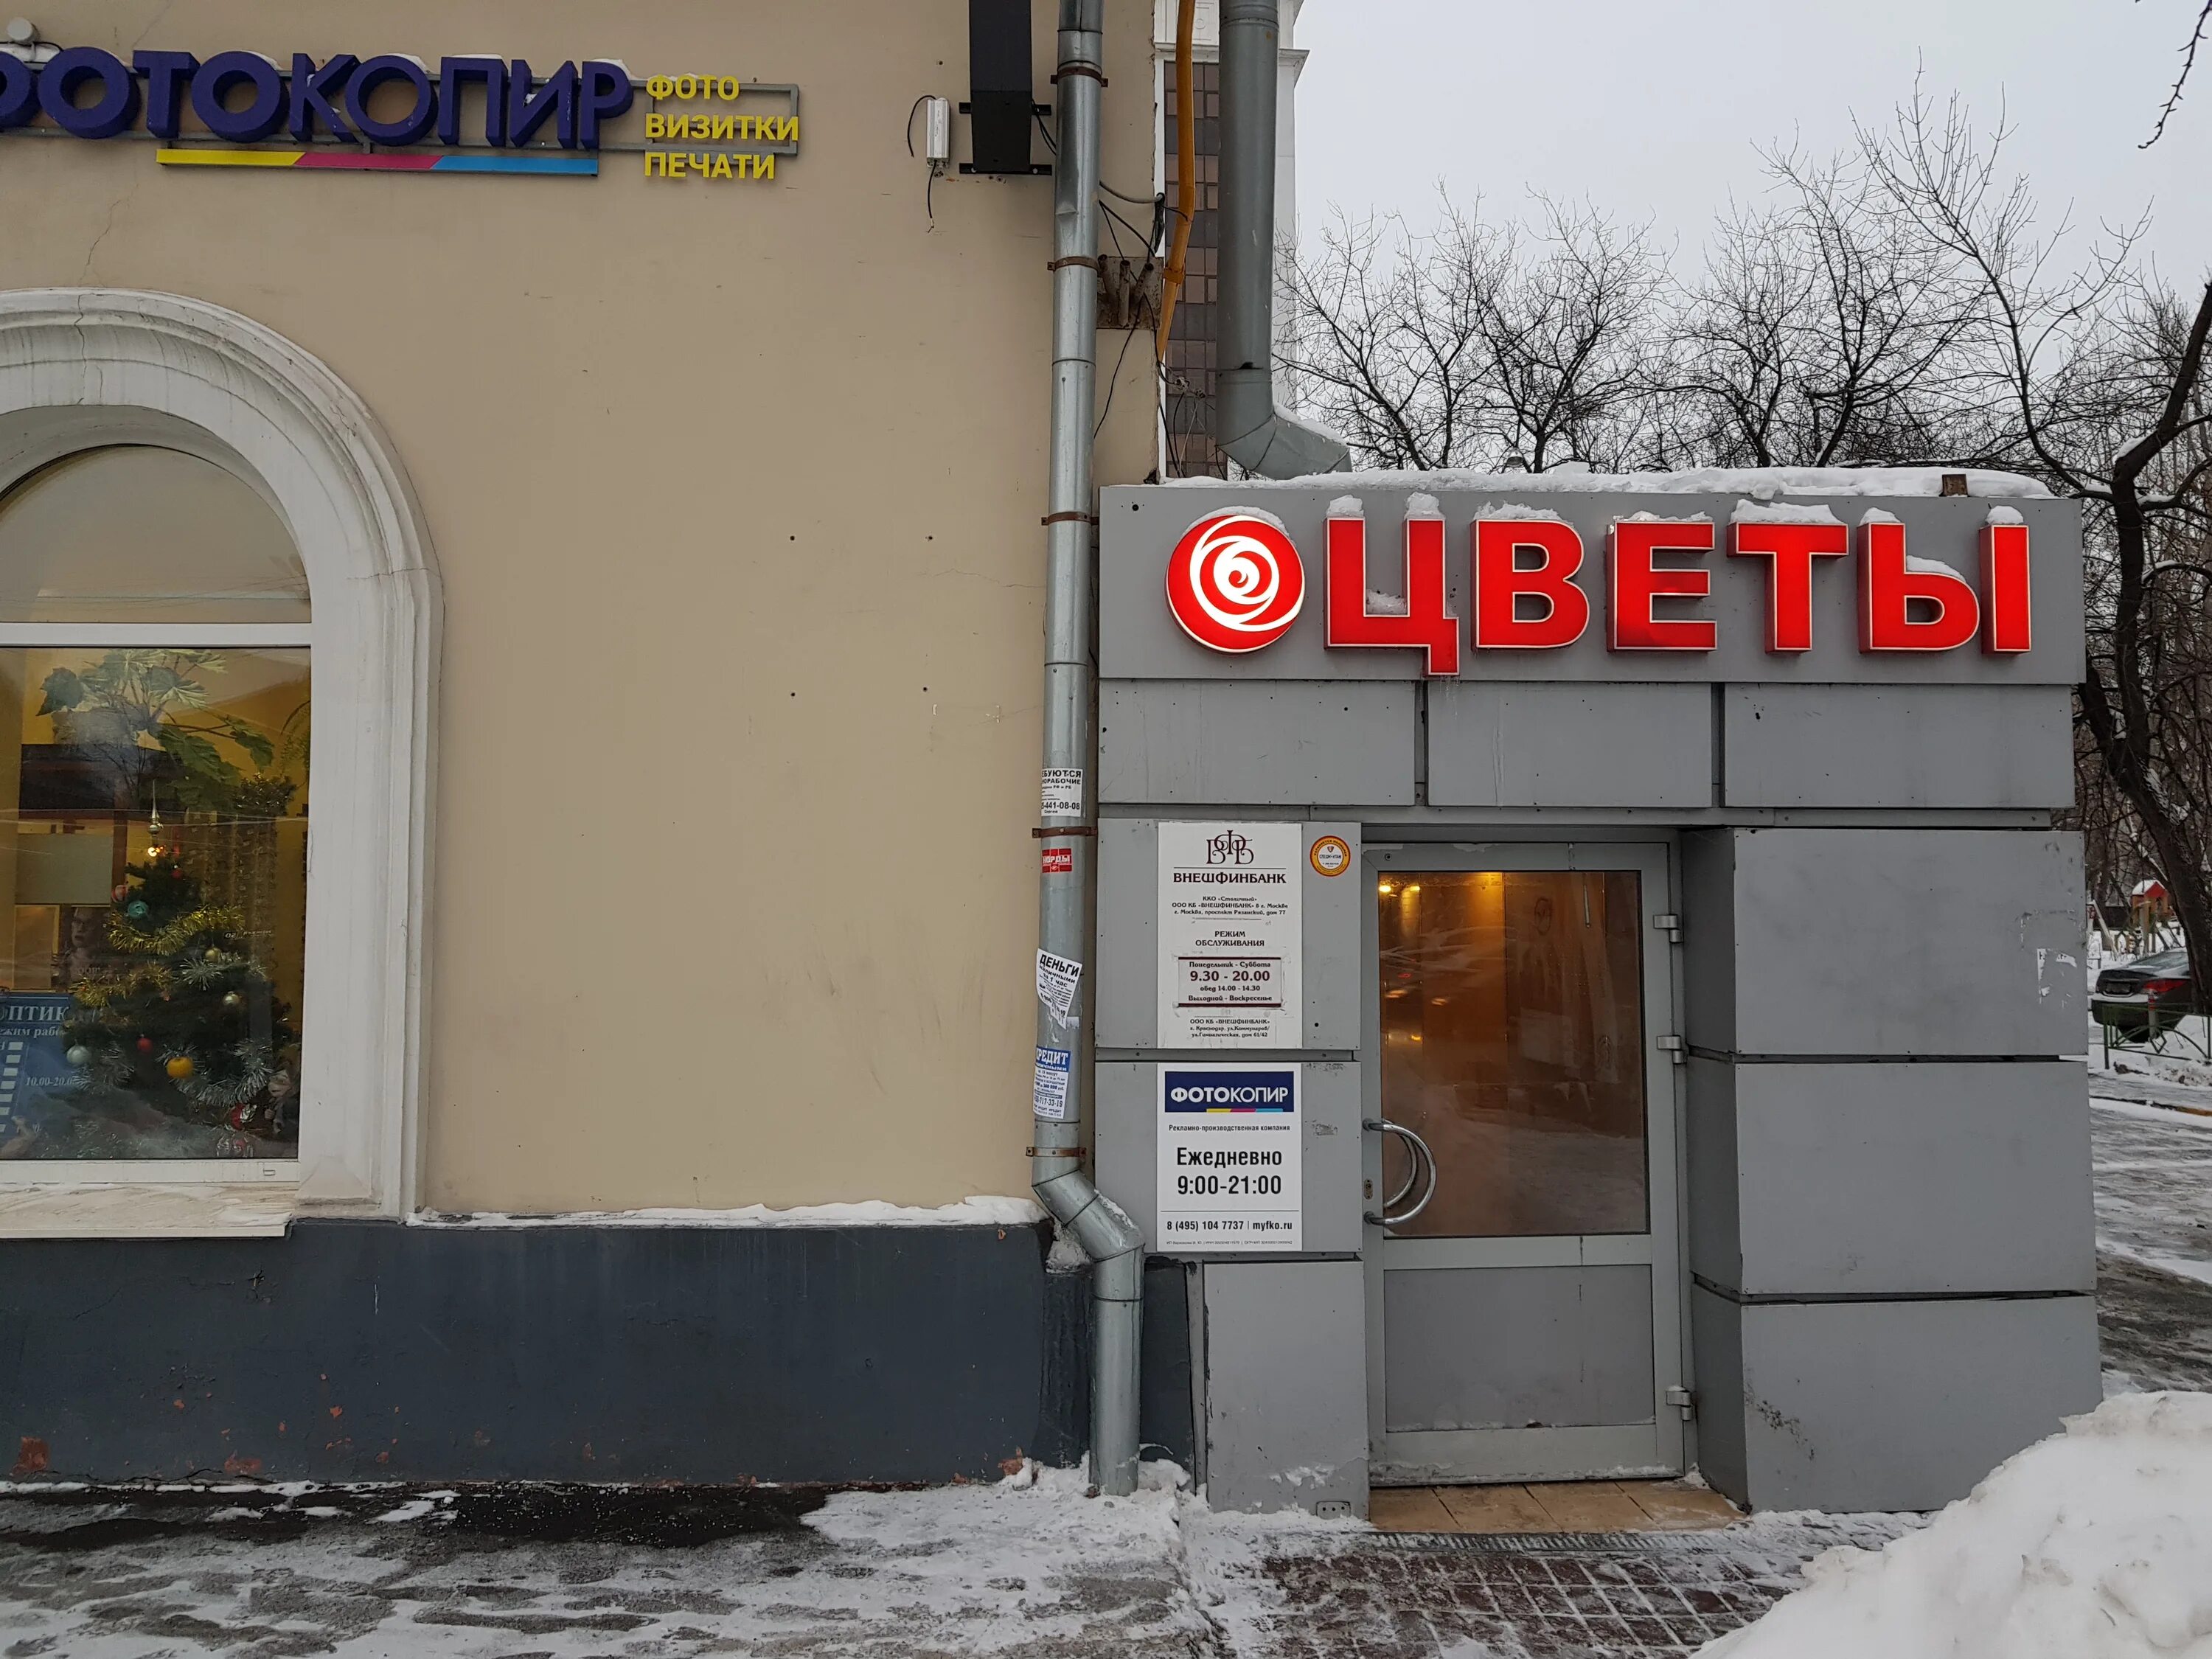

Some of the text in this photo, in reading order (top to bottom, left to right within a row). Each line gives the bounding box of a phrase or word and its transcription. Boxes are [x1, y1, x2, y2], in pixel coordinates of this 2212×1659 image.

[646, 74, 740, 100] ФОТО
[645, 113, 799, 141] ВИЗИТКИ
[644, 152, 775, 179] ПЕЧАТИ
[1324, 516, 2031, 676] ЦВЕТЫ
[1173, 872, 1287, 884] ВНЕШФИНБАНК
[1040, 954, 1079, 977] ДЕНЬГИ
[1040, 964, 1075, 984] наличными
[1055, 979, 1068, 987] час
[1190, 970, 1220, 981] 9.30
[1232, 970, 1270, 981] 20.00
[0, 1005, 70, 1022] ПТИК
[26, 1077, 73, 1086] 10.00-20.0
[1170, 1087, 1289, 1103] ФОТОКОПИР
[1177, 1147, 1282, 1168] Ежедневно
[1178, 1175, 1281, 1194] 9:00-21:00
[1166, 1220, 1293, 1232] 8 (495) 104 7737 myfko.ru
